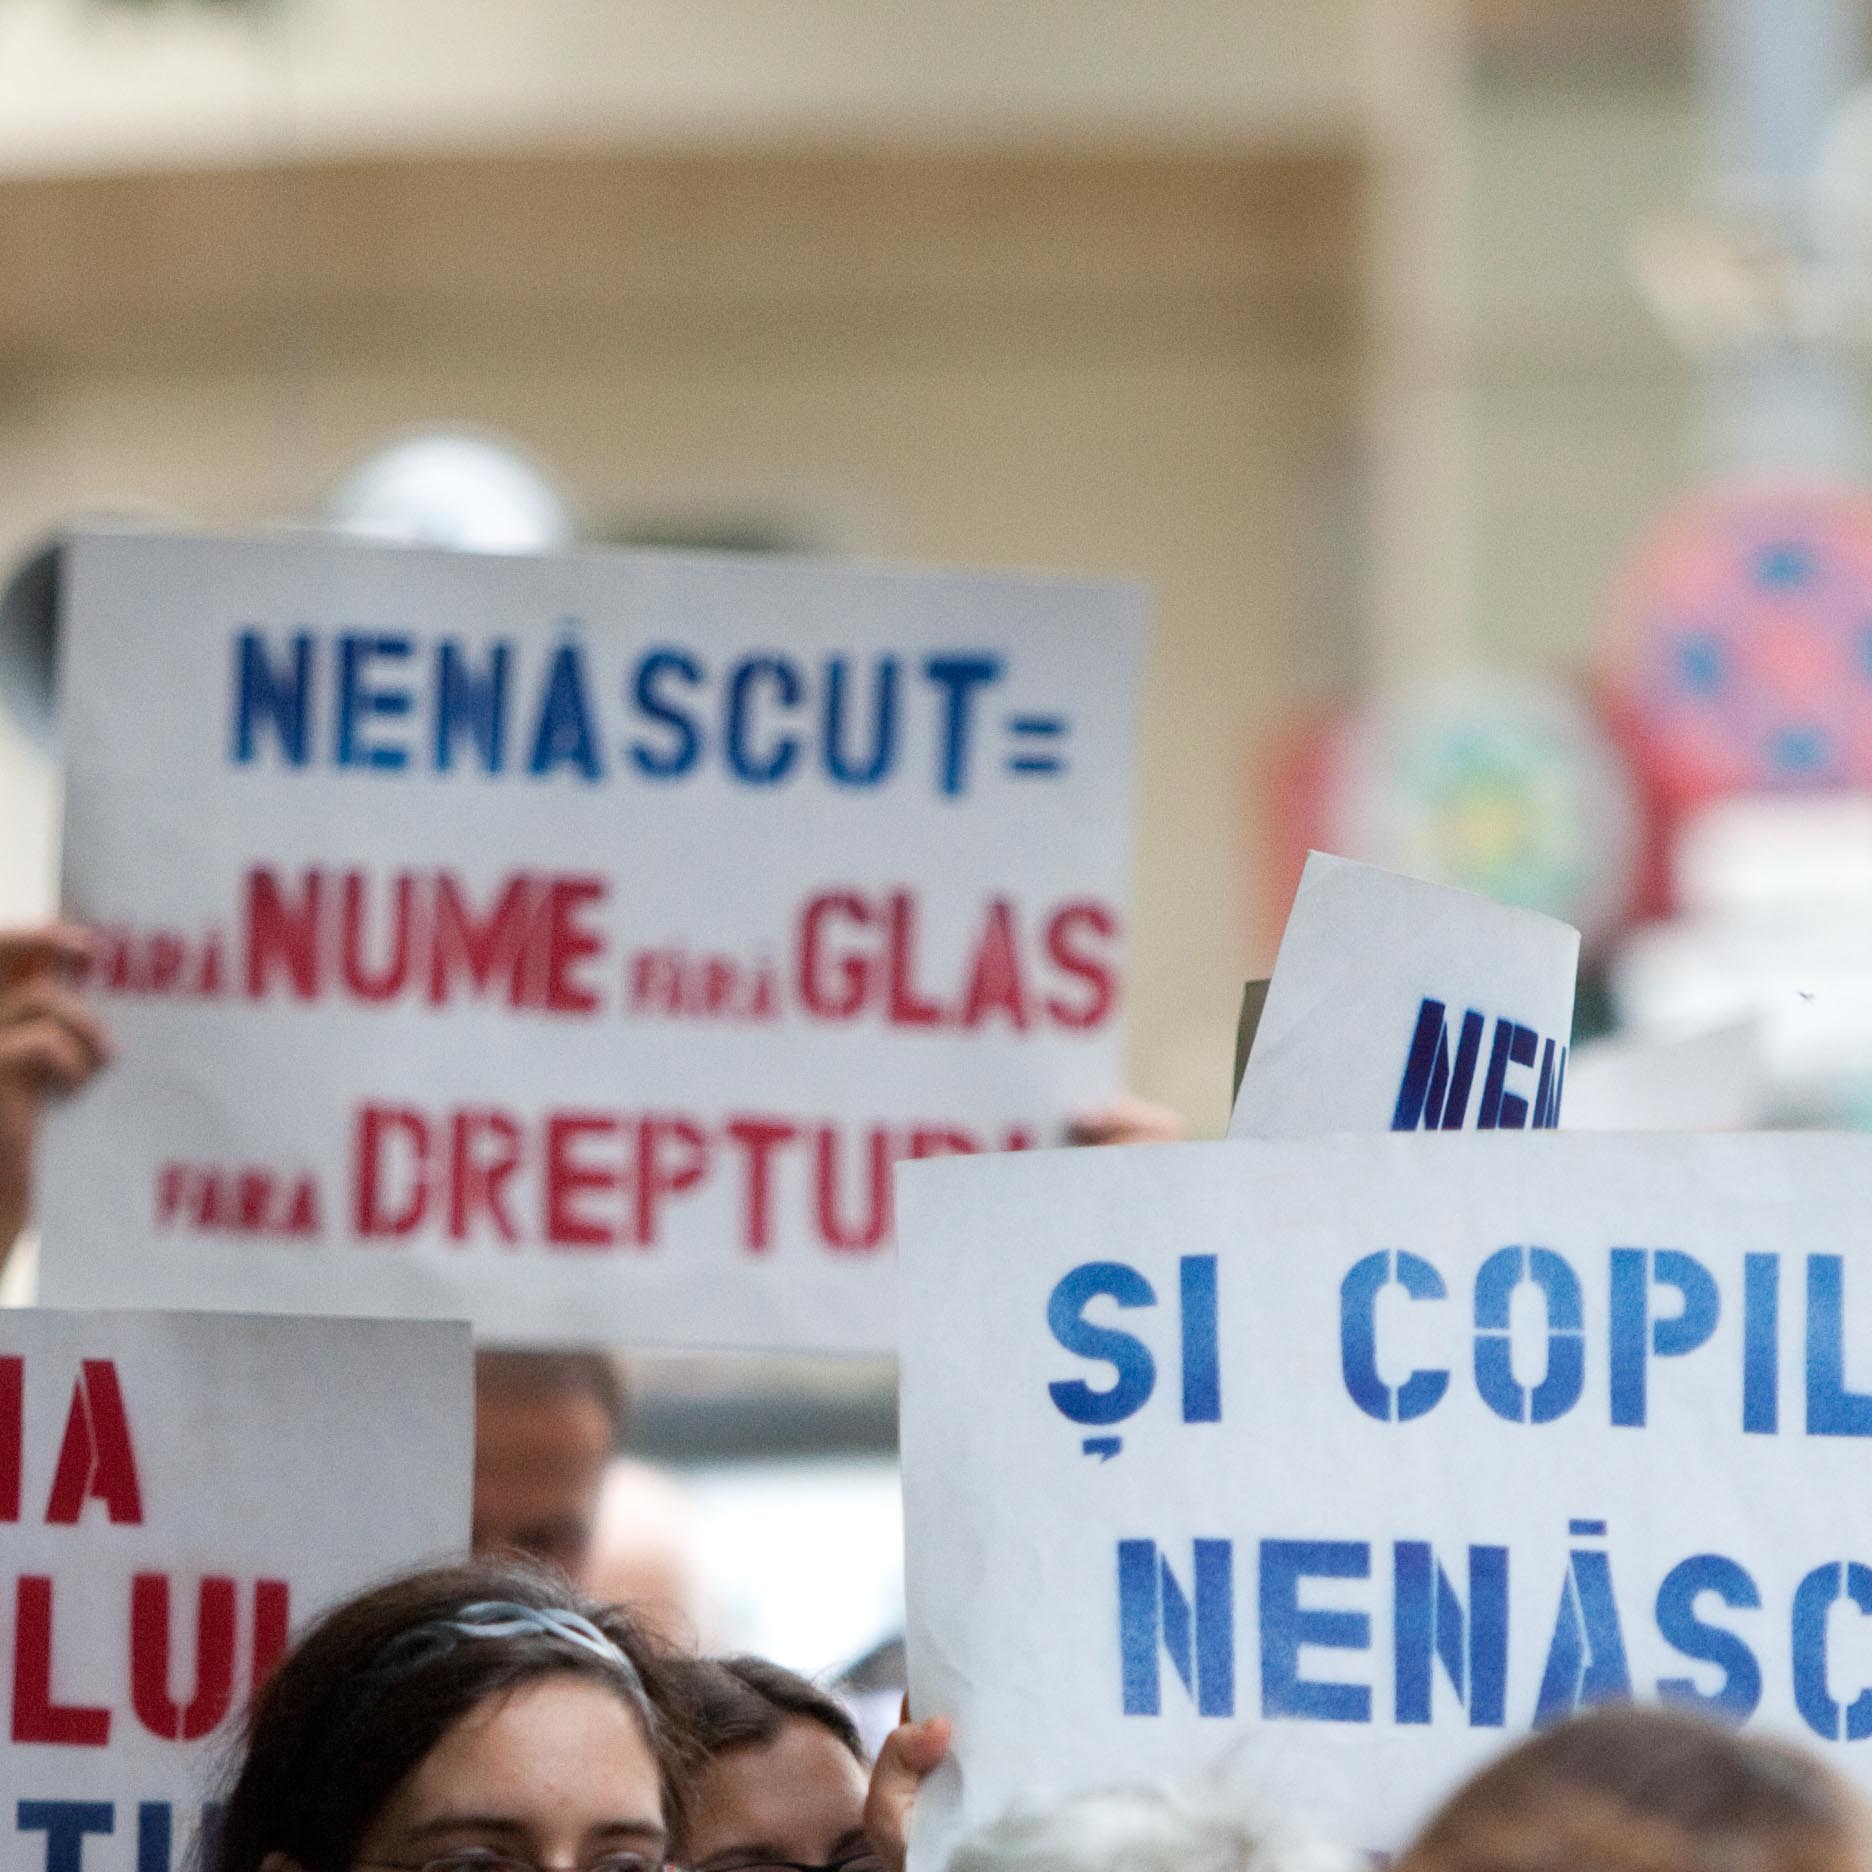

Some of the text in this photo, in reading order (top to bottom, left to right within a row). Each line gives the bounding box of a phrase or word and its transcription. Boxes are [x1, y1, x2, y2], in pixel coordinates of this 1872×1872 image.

[238, 866, 608, 1018] NUME
[792, 885, 1123, 1034] GLAS
[346, 1098, 1034, 1256] DREPTU
